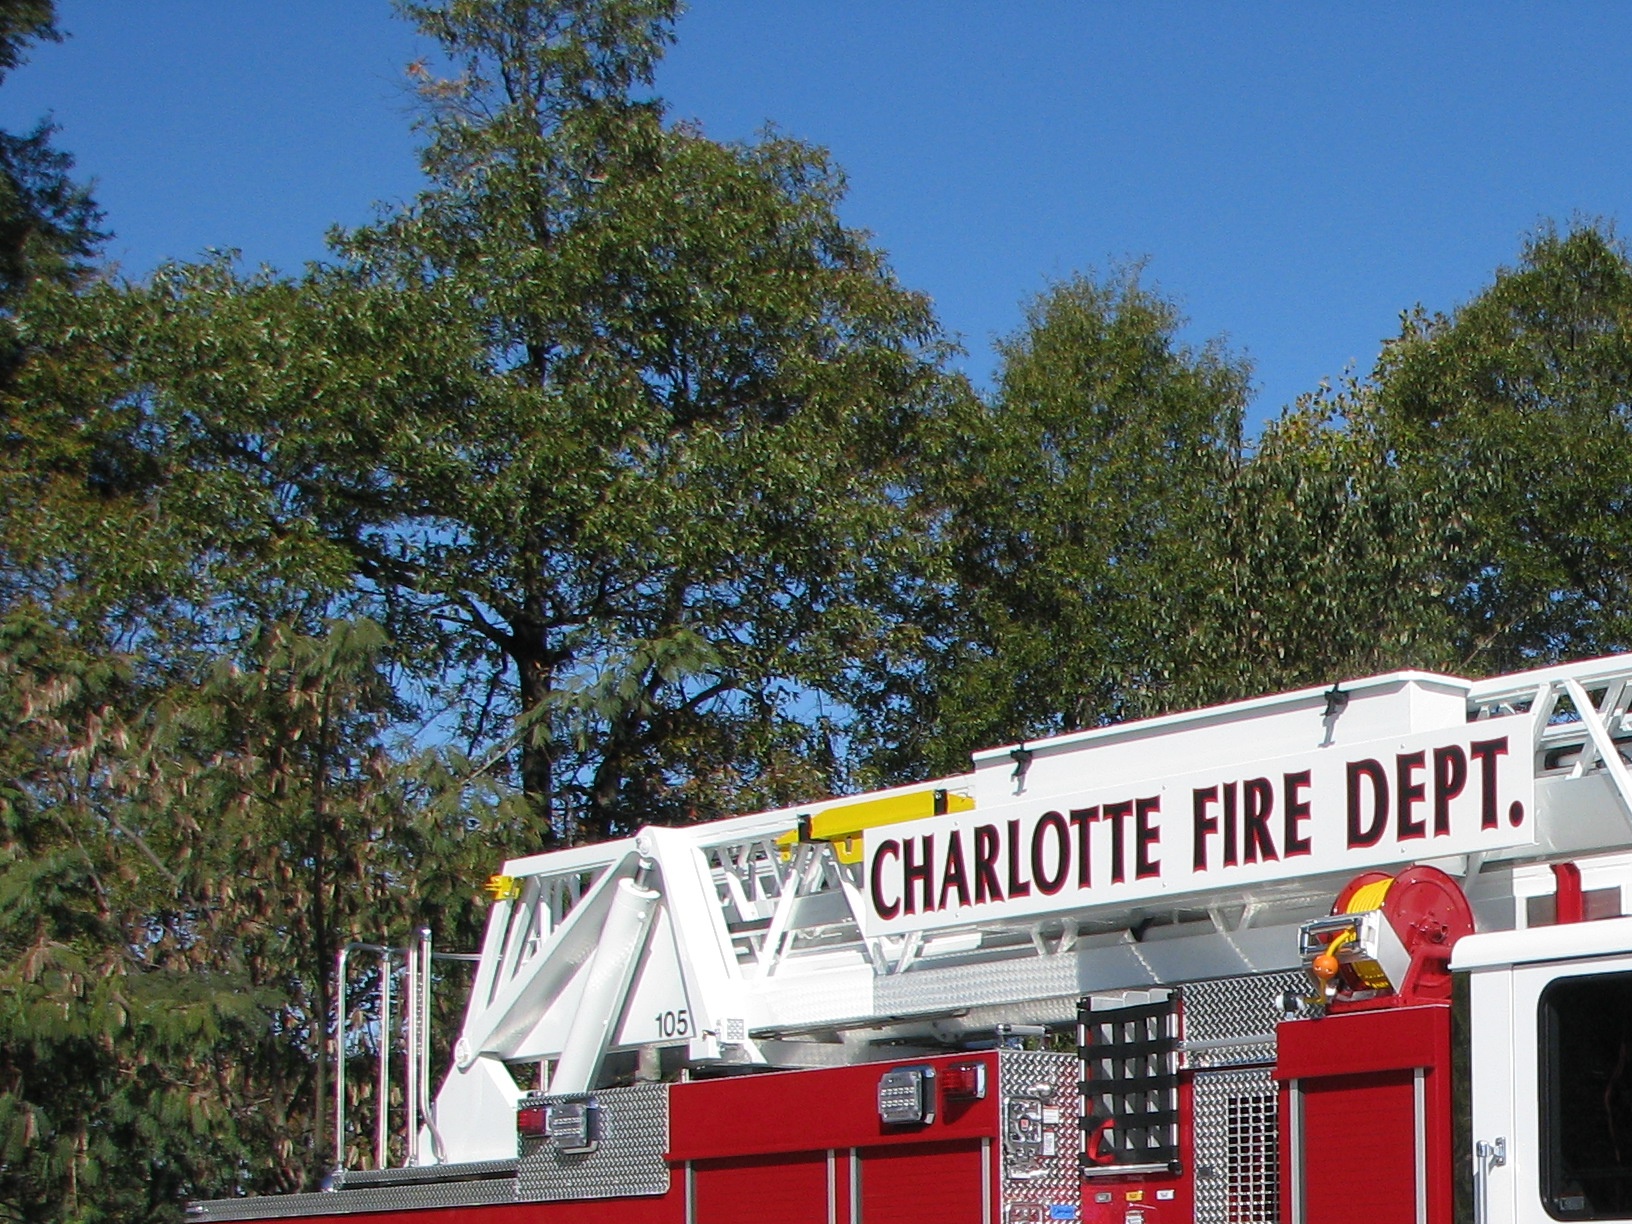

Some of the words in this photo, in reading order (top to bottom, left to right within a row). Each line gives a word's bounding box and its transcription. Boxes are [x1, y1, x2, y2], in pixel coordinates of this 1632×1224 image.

[870, 796, 1162, 921] CHARLOTTE
[1192, 768, 1312, 872] FIRE
[1345, 736, 1525, 850] DEPT.
[654, 1009, 689, 1038] 105
